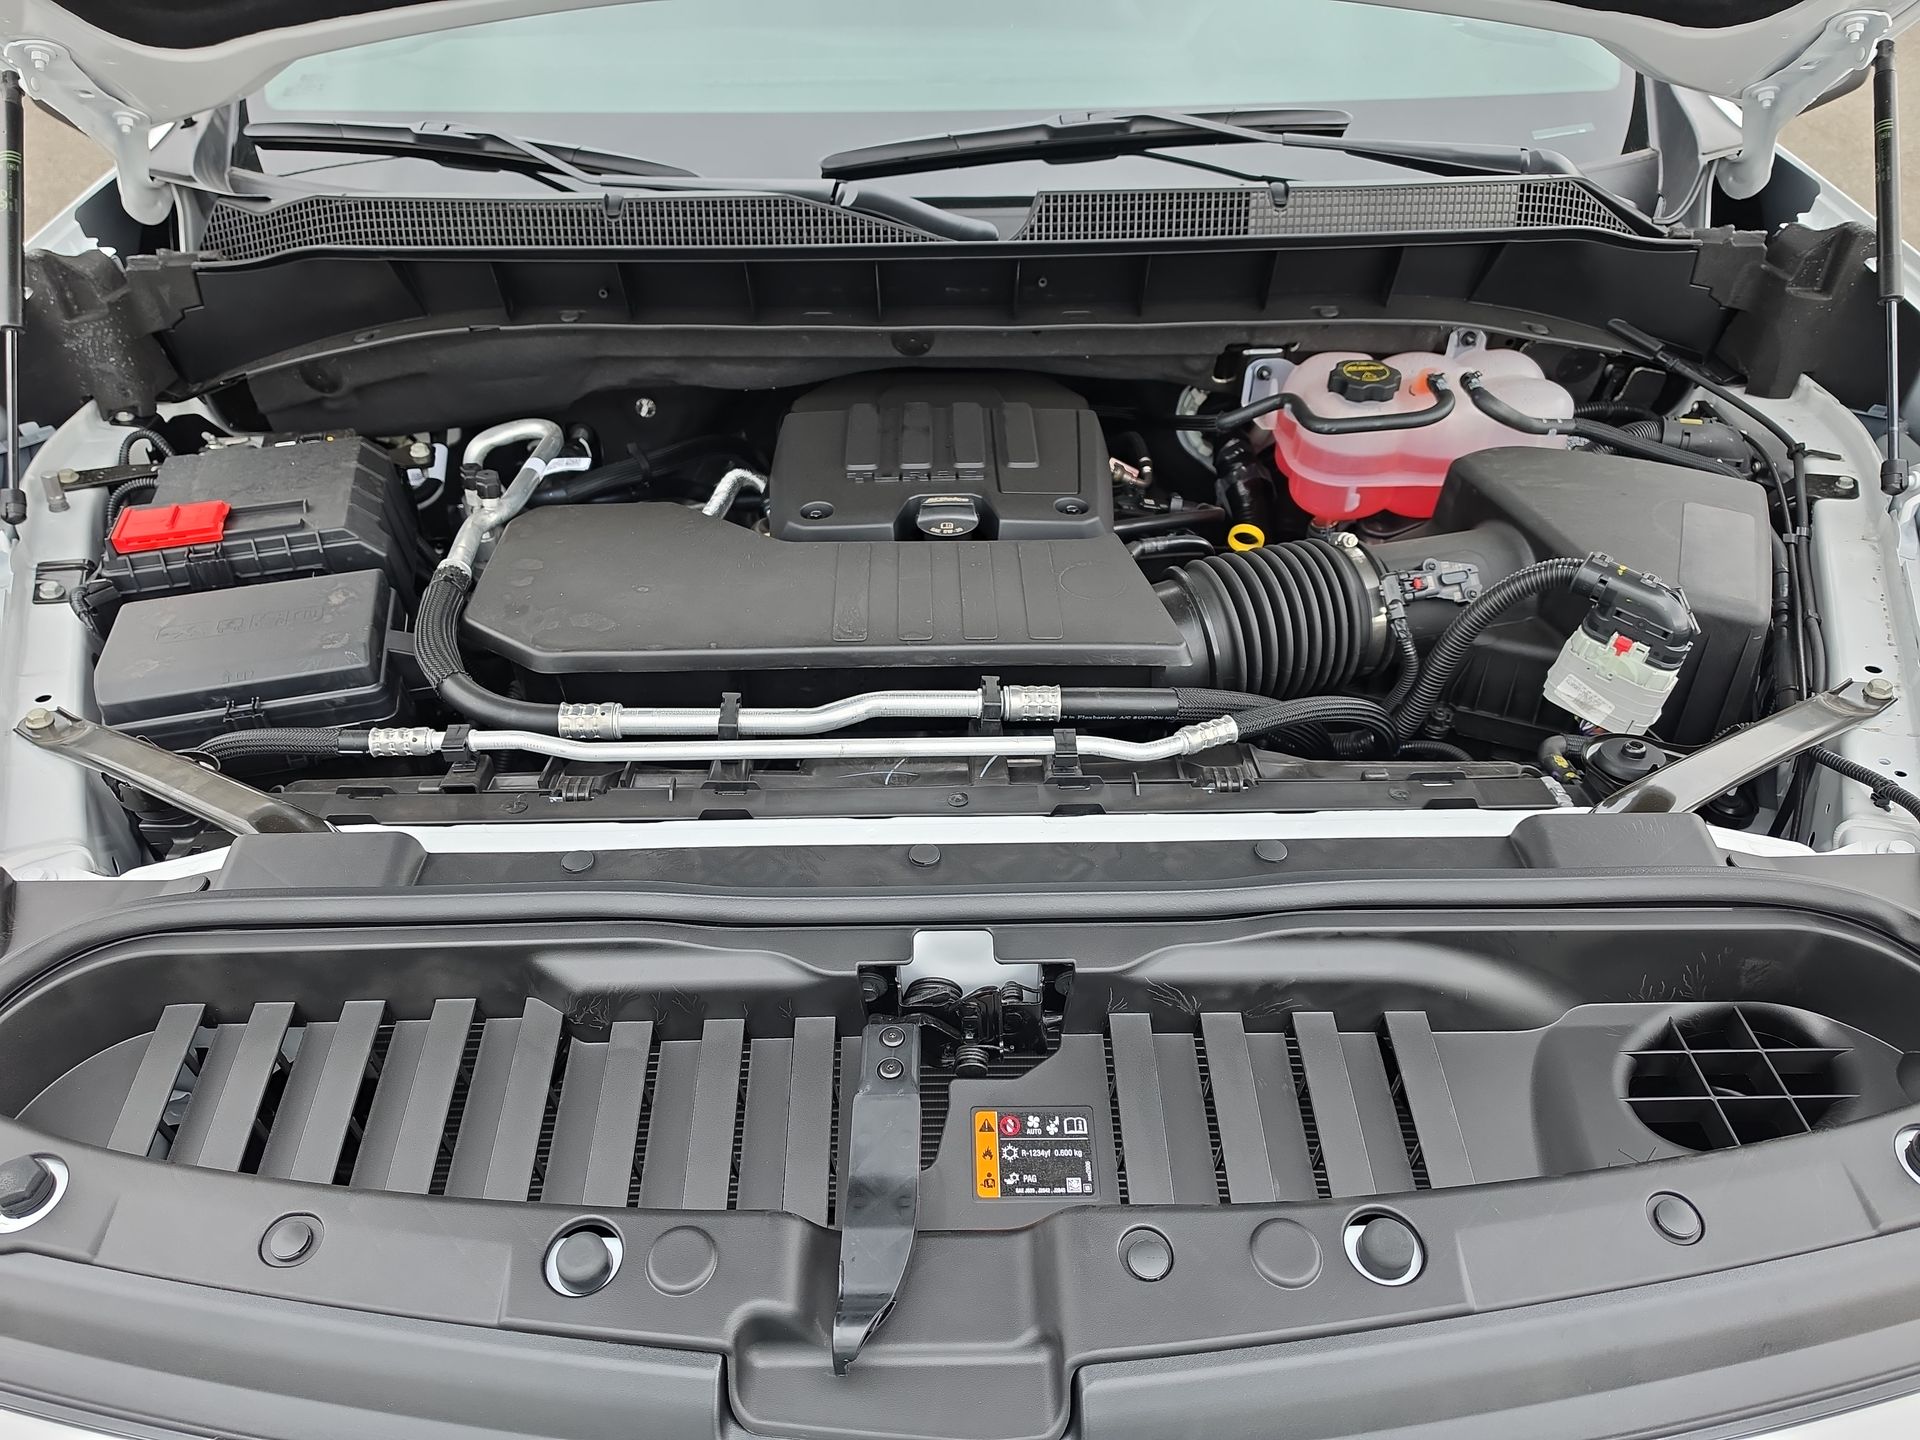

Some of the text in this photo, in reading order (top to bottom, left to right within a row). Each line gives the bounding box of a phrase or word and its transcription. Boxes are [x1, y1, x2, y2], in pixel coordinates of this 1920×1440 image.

[1021, 1149, 1083, 1158] R-1234yf 0.600 kg
[1023, 1174, 1037, 1183] PAG
